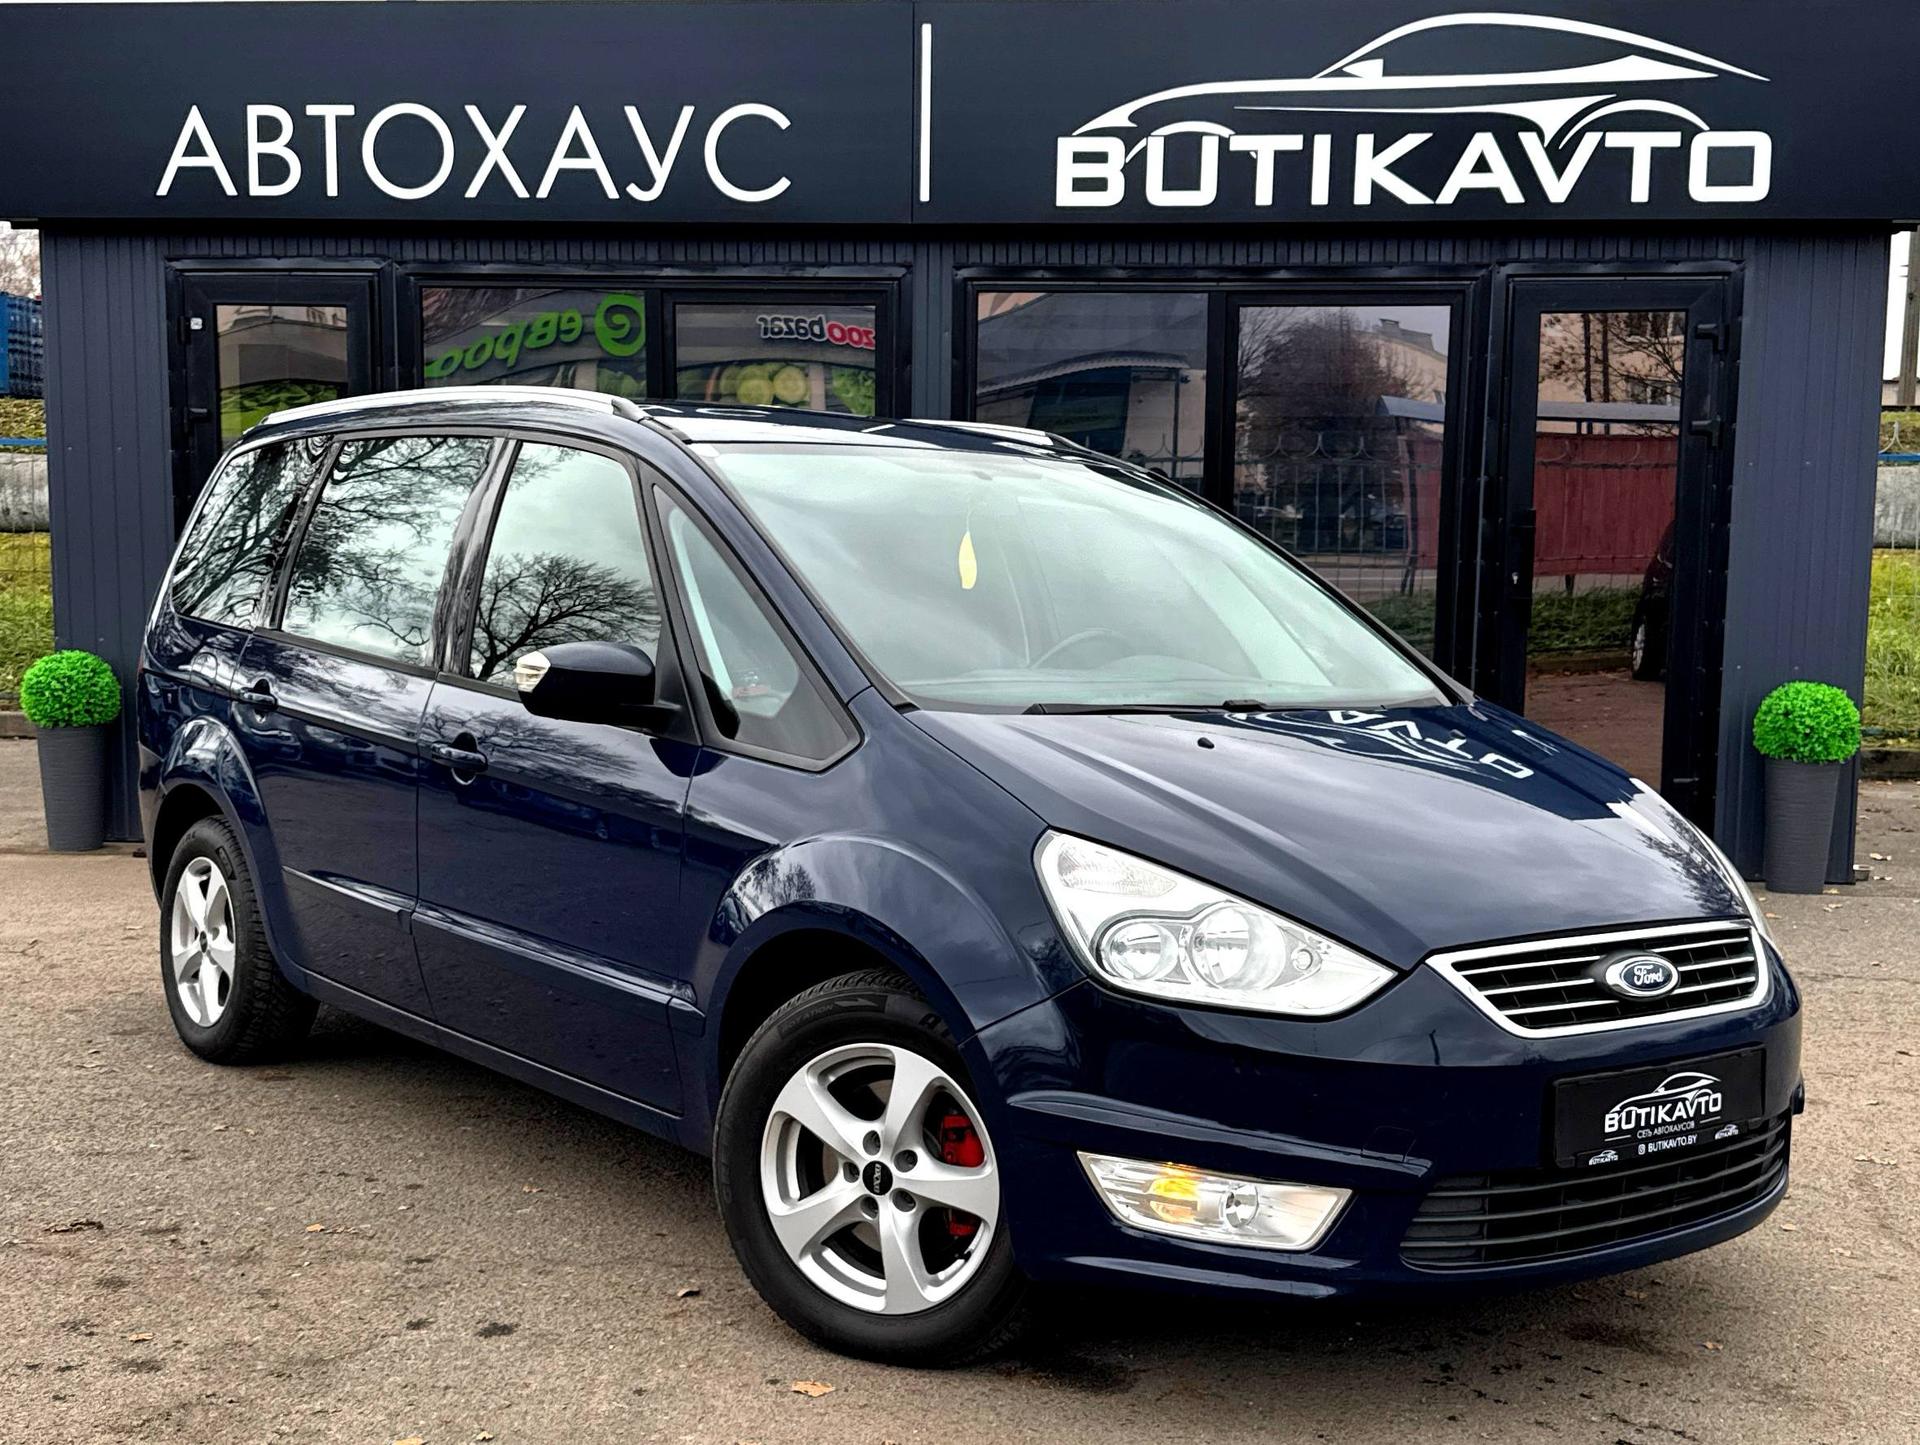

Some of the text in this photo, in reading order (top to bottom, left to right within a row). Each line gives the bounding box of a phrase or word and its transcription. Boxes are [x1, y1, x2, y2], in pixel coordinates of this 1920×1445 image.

[155, 103, 793, 203] АВТОХАУС
[1055, 130, 1773, 208] BUTIKAVTO
[1633, 964, 1665, 986] Ford
[1604, 1092, 1722, 1133] BUTIKAVTO
